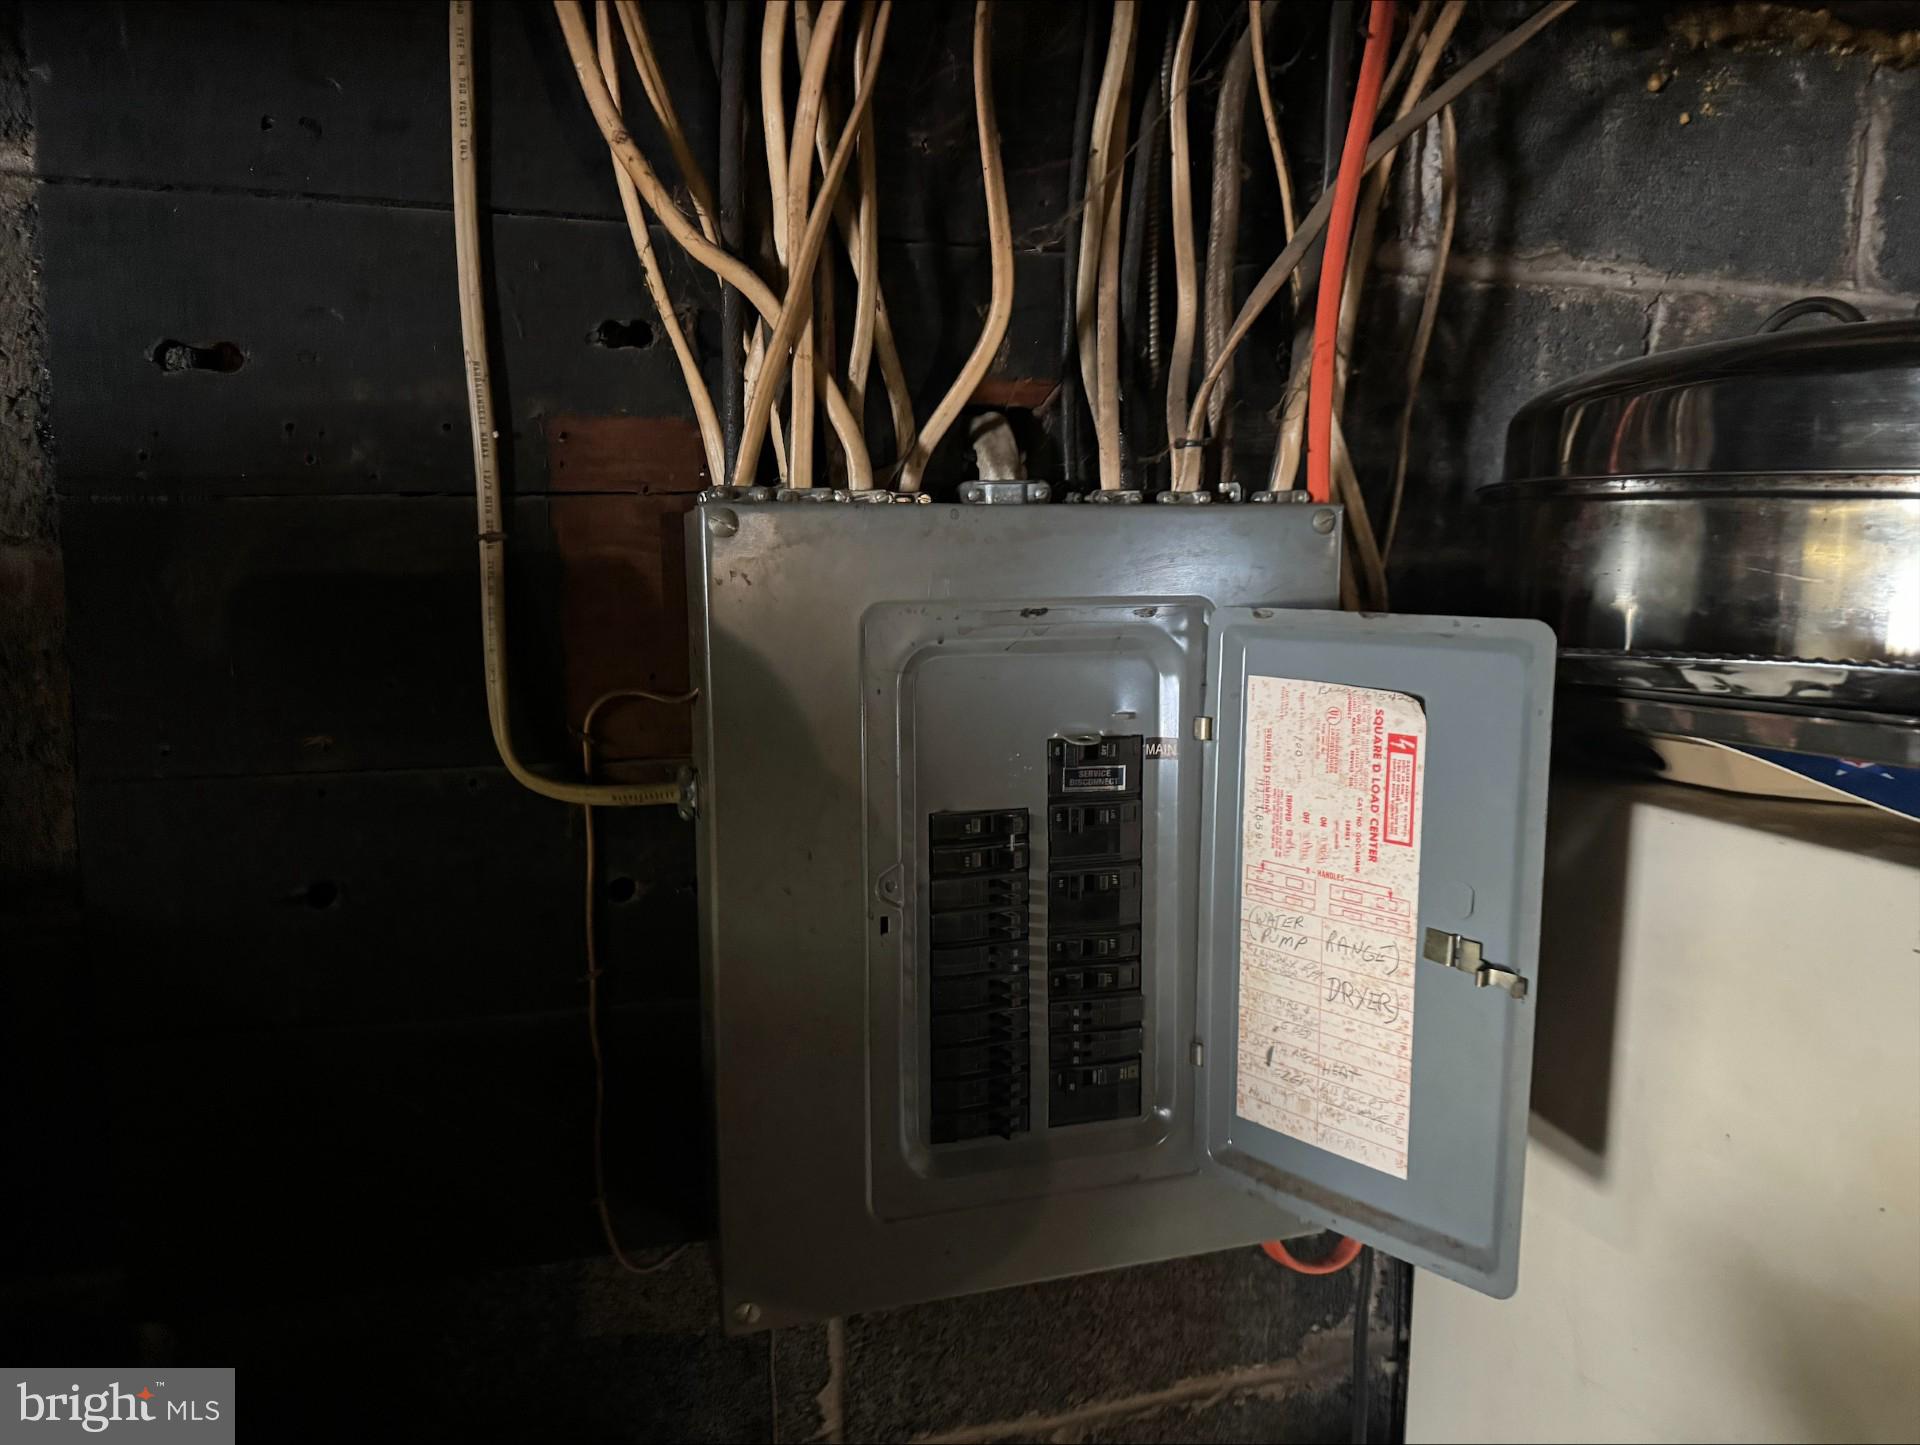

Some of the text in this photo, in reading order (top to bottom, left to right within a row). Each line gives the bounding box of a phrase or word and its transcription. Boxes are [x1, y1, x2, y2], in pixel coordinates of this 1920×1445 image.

[459, 100, 468, 128] VOLTS
[1146, 744, 1176, 755] MAIN
[1078, 769, 1112, 778] SERVICE
[1264, 765, 1272, 773] D
[1070, 778, 1118, 786] DISCONNECT
[1368, 708, 1384, 864] SQUARE D LOAD CENTER
[1285, 795, 1294, 822] TRIPPED
[1302, 811, 1310, 825] OFF
[1320, 816, 1328, 828] ON
[1317, 870, 1344, 882] HANDLES
[1261, 927, 1308, 950] PUMP
[1322, 1062, 1362, 1082] HEAT
